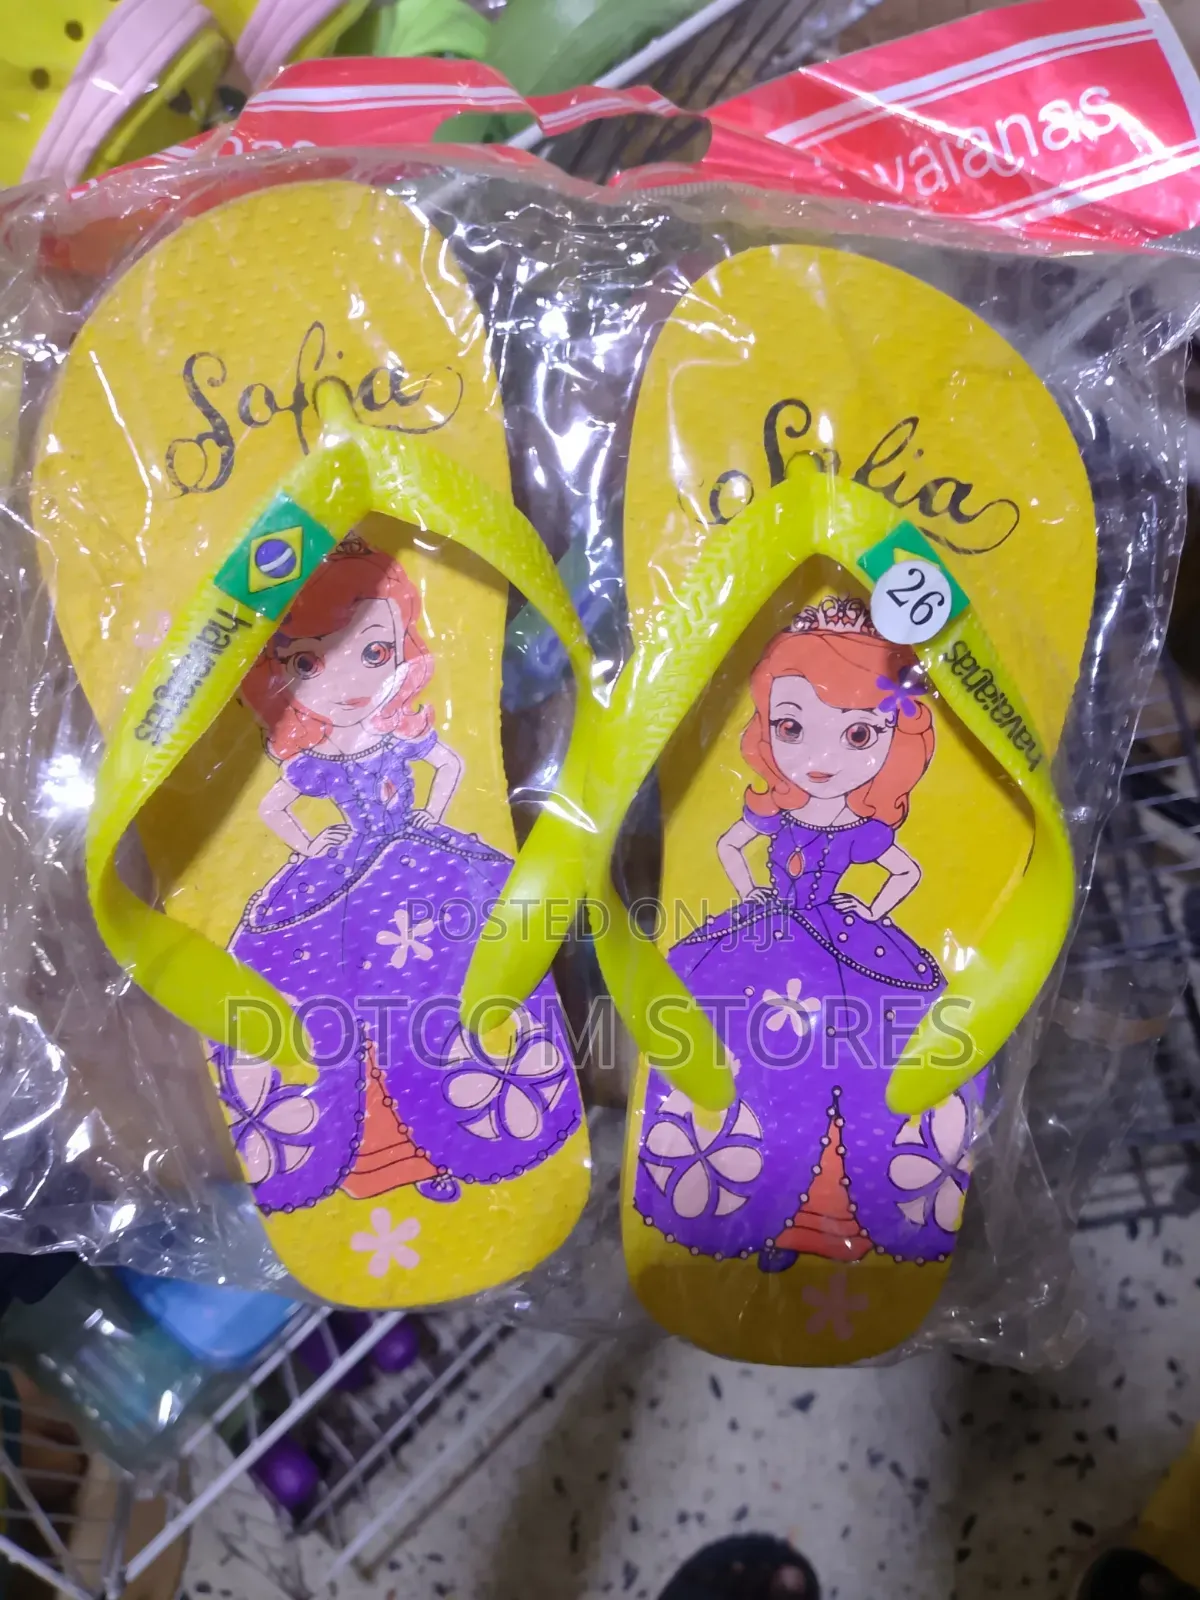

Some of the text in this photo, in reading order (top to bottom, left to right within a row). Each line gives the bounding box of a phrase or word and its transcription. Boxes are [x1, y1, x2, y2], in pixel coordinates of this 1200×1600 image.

[165, 320, 464, 498] Sofa
[886, 567, 945, 626] 26
[942, 640, 1043, 773] havaianas
